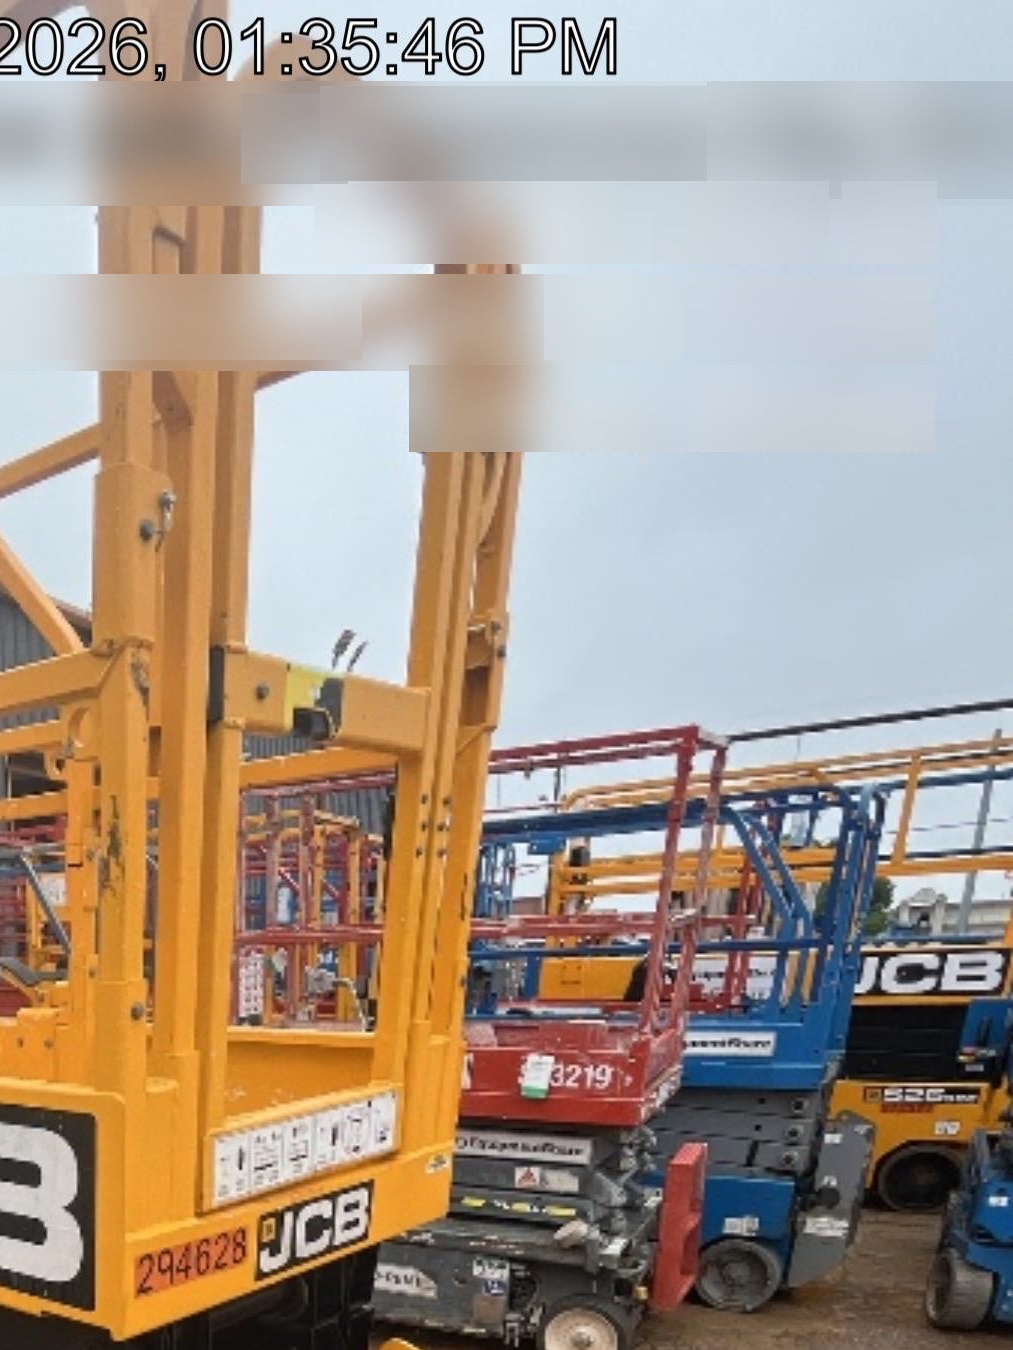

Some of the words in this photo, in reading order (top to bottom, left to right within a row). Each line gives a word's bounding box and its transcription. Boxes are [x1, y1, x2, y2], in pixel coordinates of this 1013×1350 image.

[854, 952, 1004, 993] JCB
[551, 1063, 615, 1090] 3219
[259, 1187, 369, 1273] JCB
[137, 1229, 247, 1294] 294628
